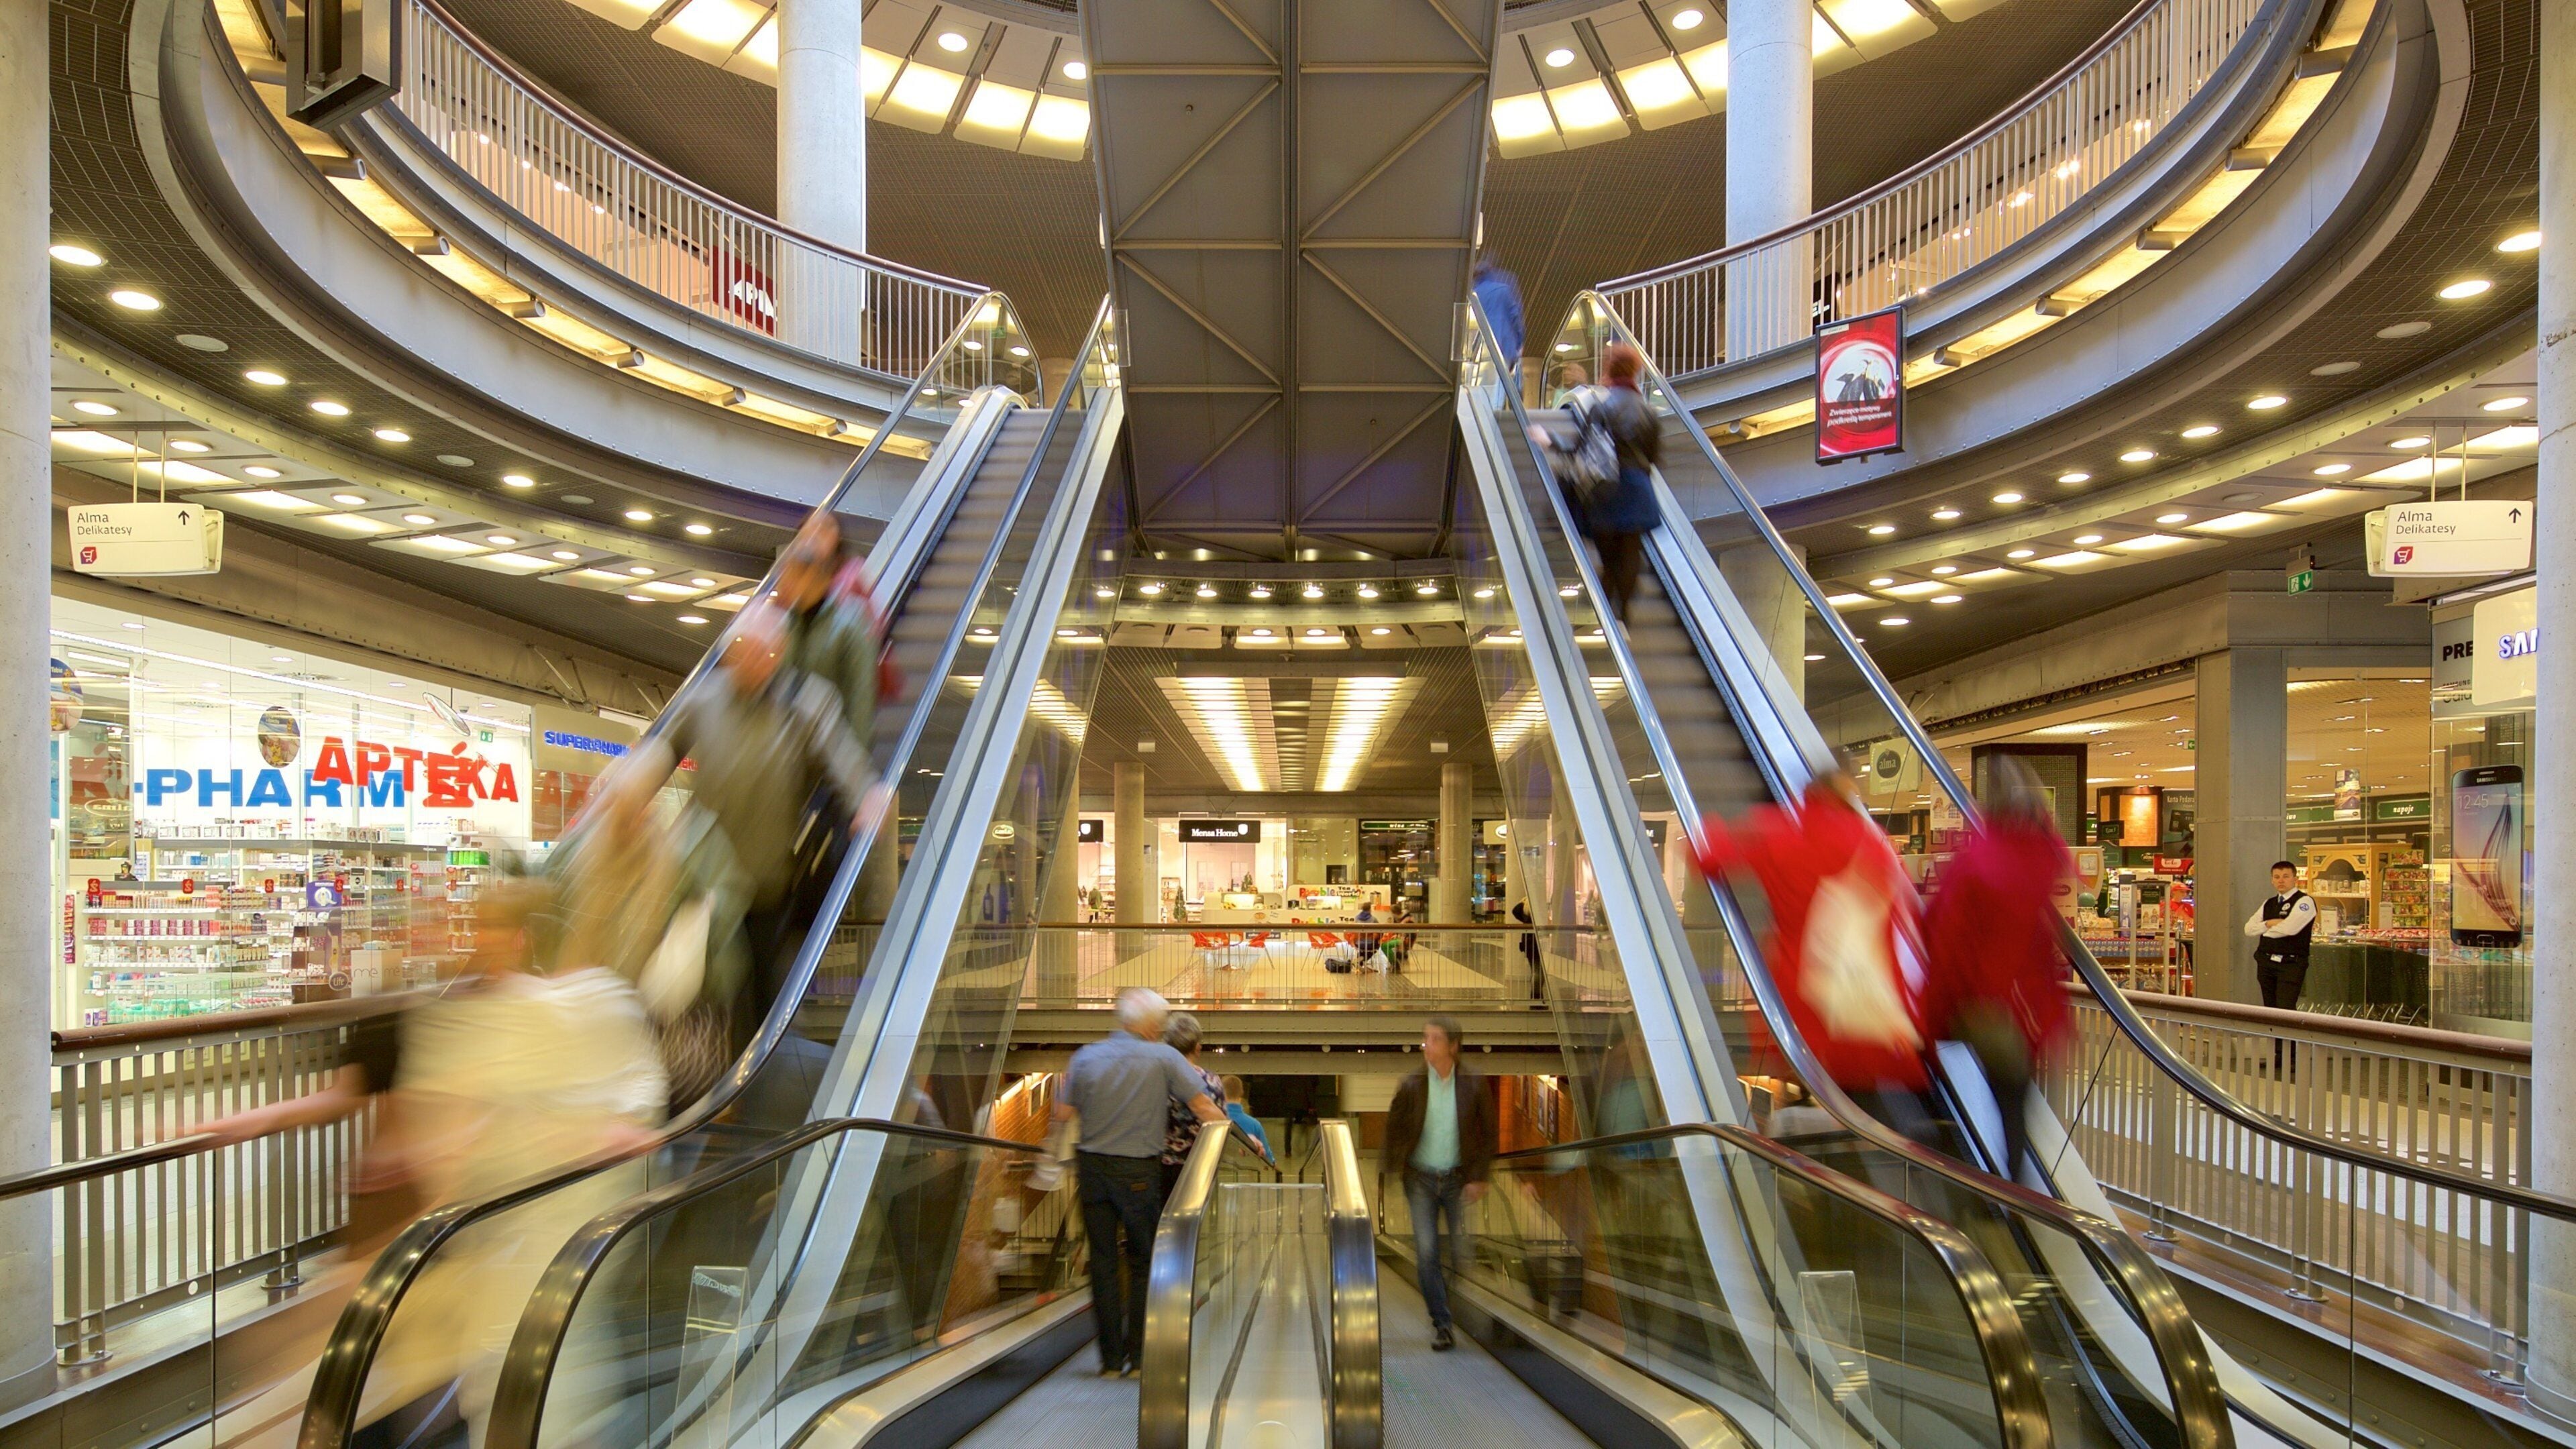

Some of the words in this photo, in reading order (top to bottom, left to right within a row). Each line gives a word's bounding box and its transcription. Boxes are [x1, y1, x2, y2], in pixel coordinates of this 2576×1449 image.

[77, 513, 109, 523] Alma
[2398, 511, 2432, 522] Alma
[77, 525, 132, 536] Delikatesy
[2396, 524, 2456, 535] Delikatesy
[1878, 758, 1896, 770] alma
[2393, 806, 2414, 815] napoje
[1191, 828, 1215, 837] Mensa
[1216, 828, 1238, 837] Home
[333, 977, 344, 986] Life
